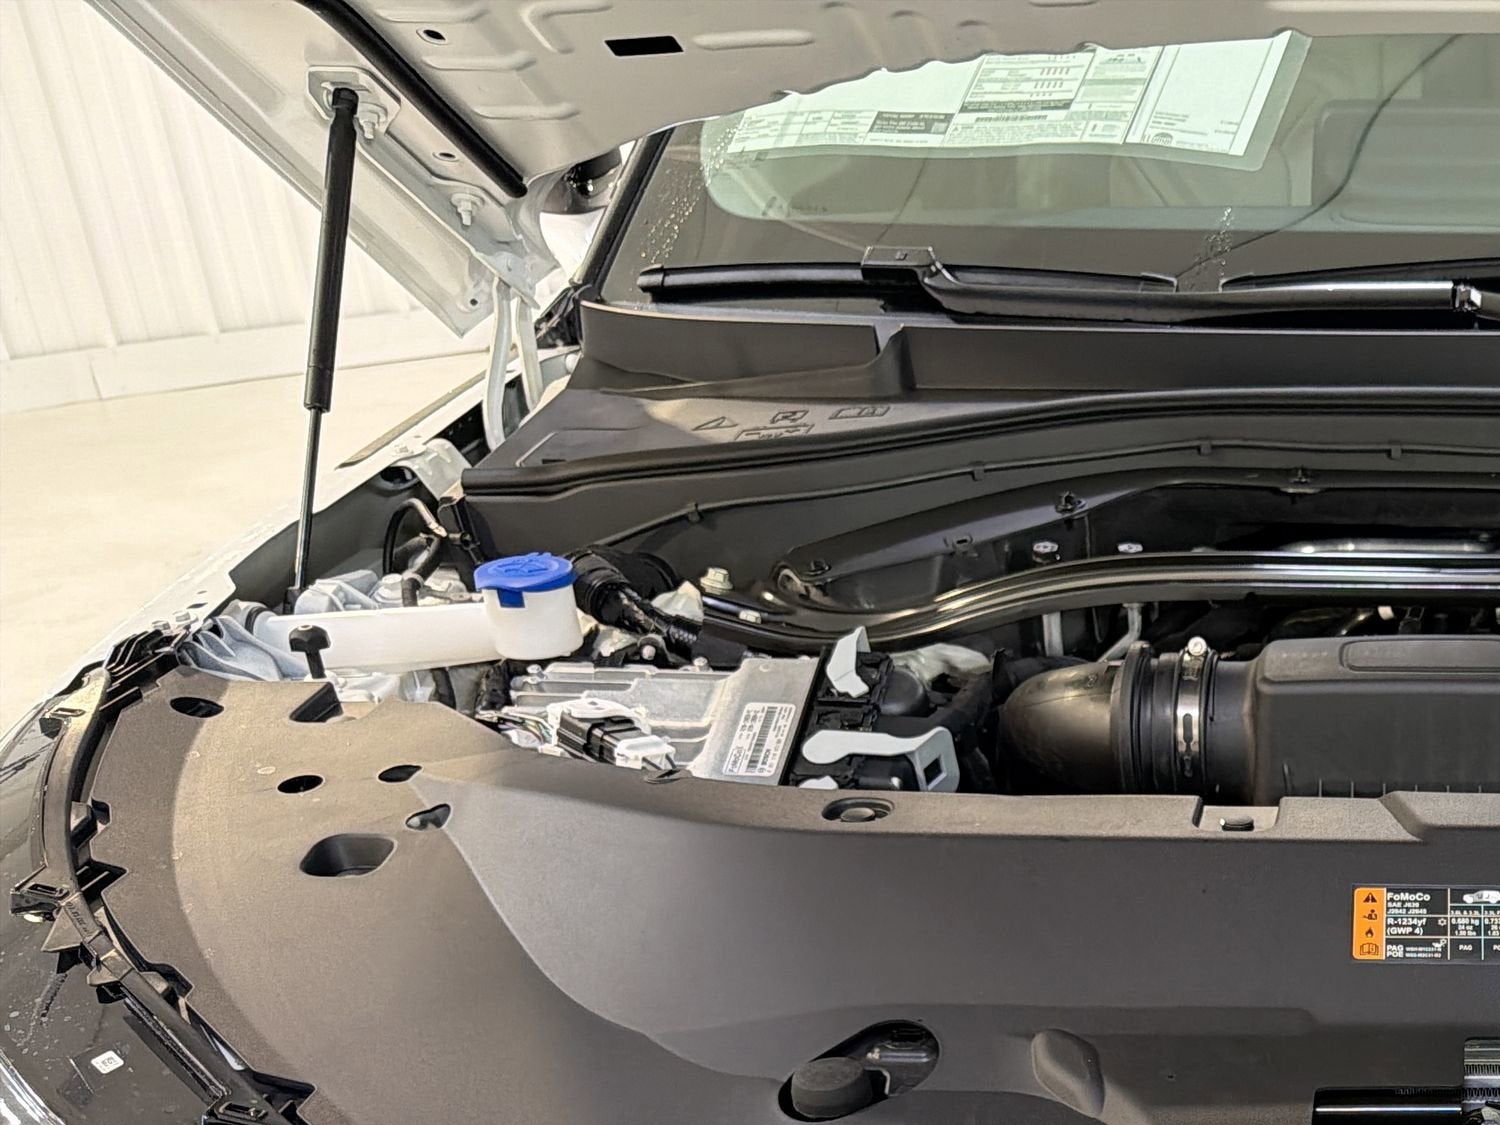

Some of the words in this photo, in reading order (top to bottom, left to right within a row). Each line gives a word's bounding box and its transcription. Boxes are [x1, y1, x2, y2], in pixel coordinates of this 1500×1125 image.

[1387, 892, 1431, 901] FoMoCo
[1387, 918, 1427, 926] R-1234yf
[1471, 918, 1480, 926] kg
[1387, 927, 1413, 935] (GWP
[1414, 927, 1424, 935] 4)
